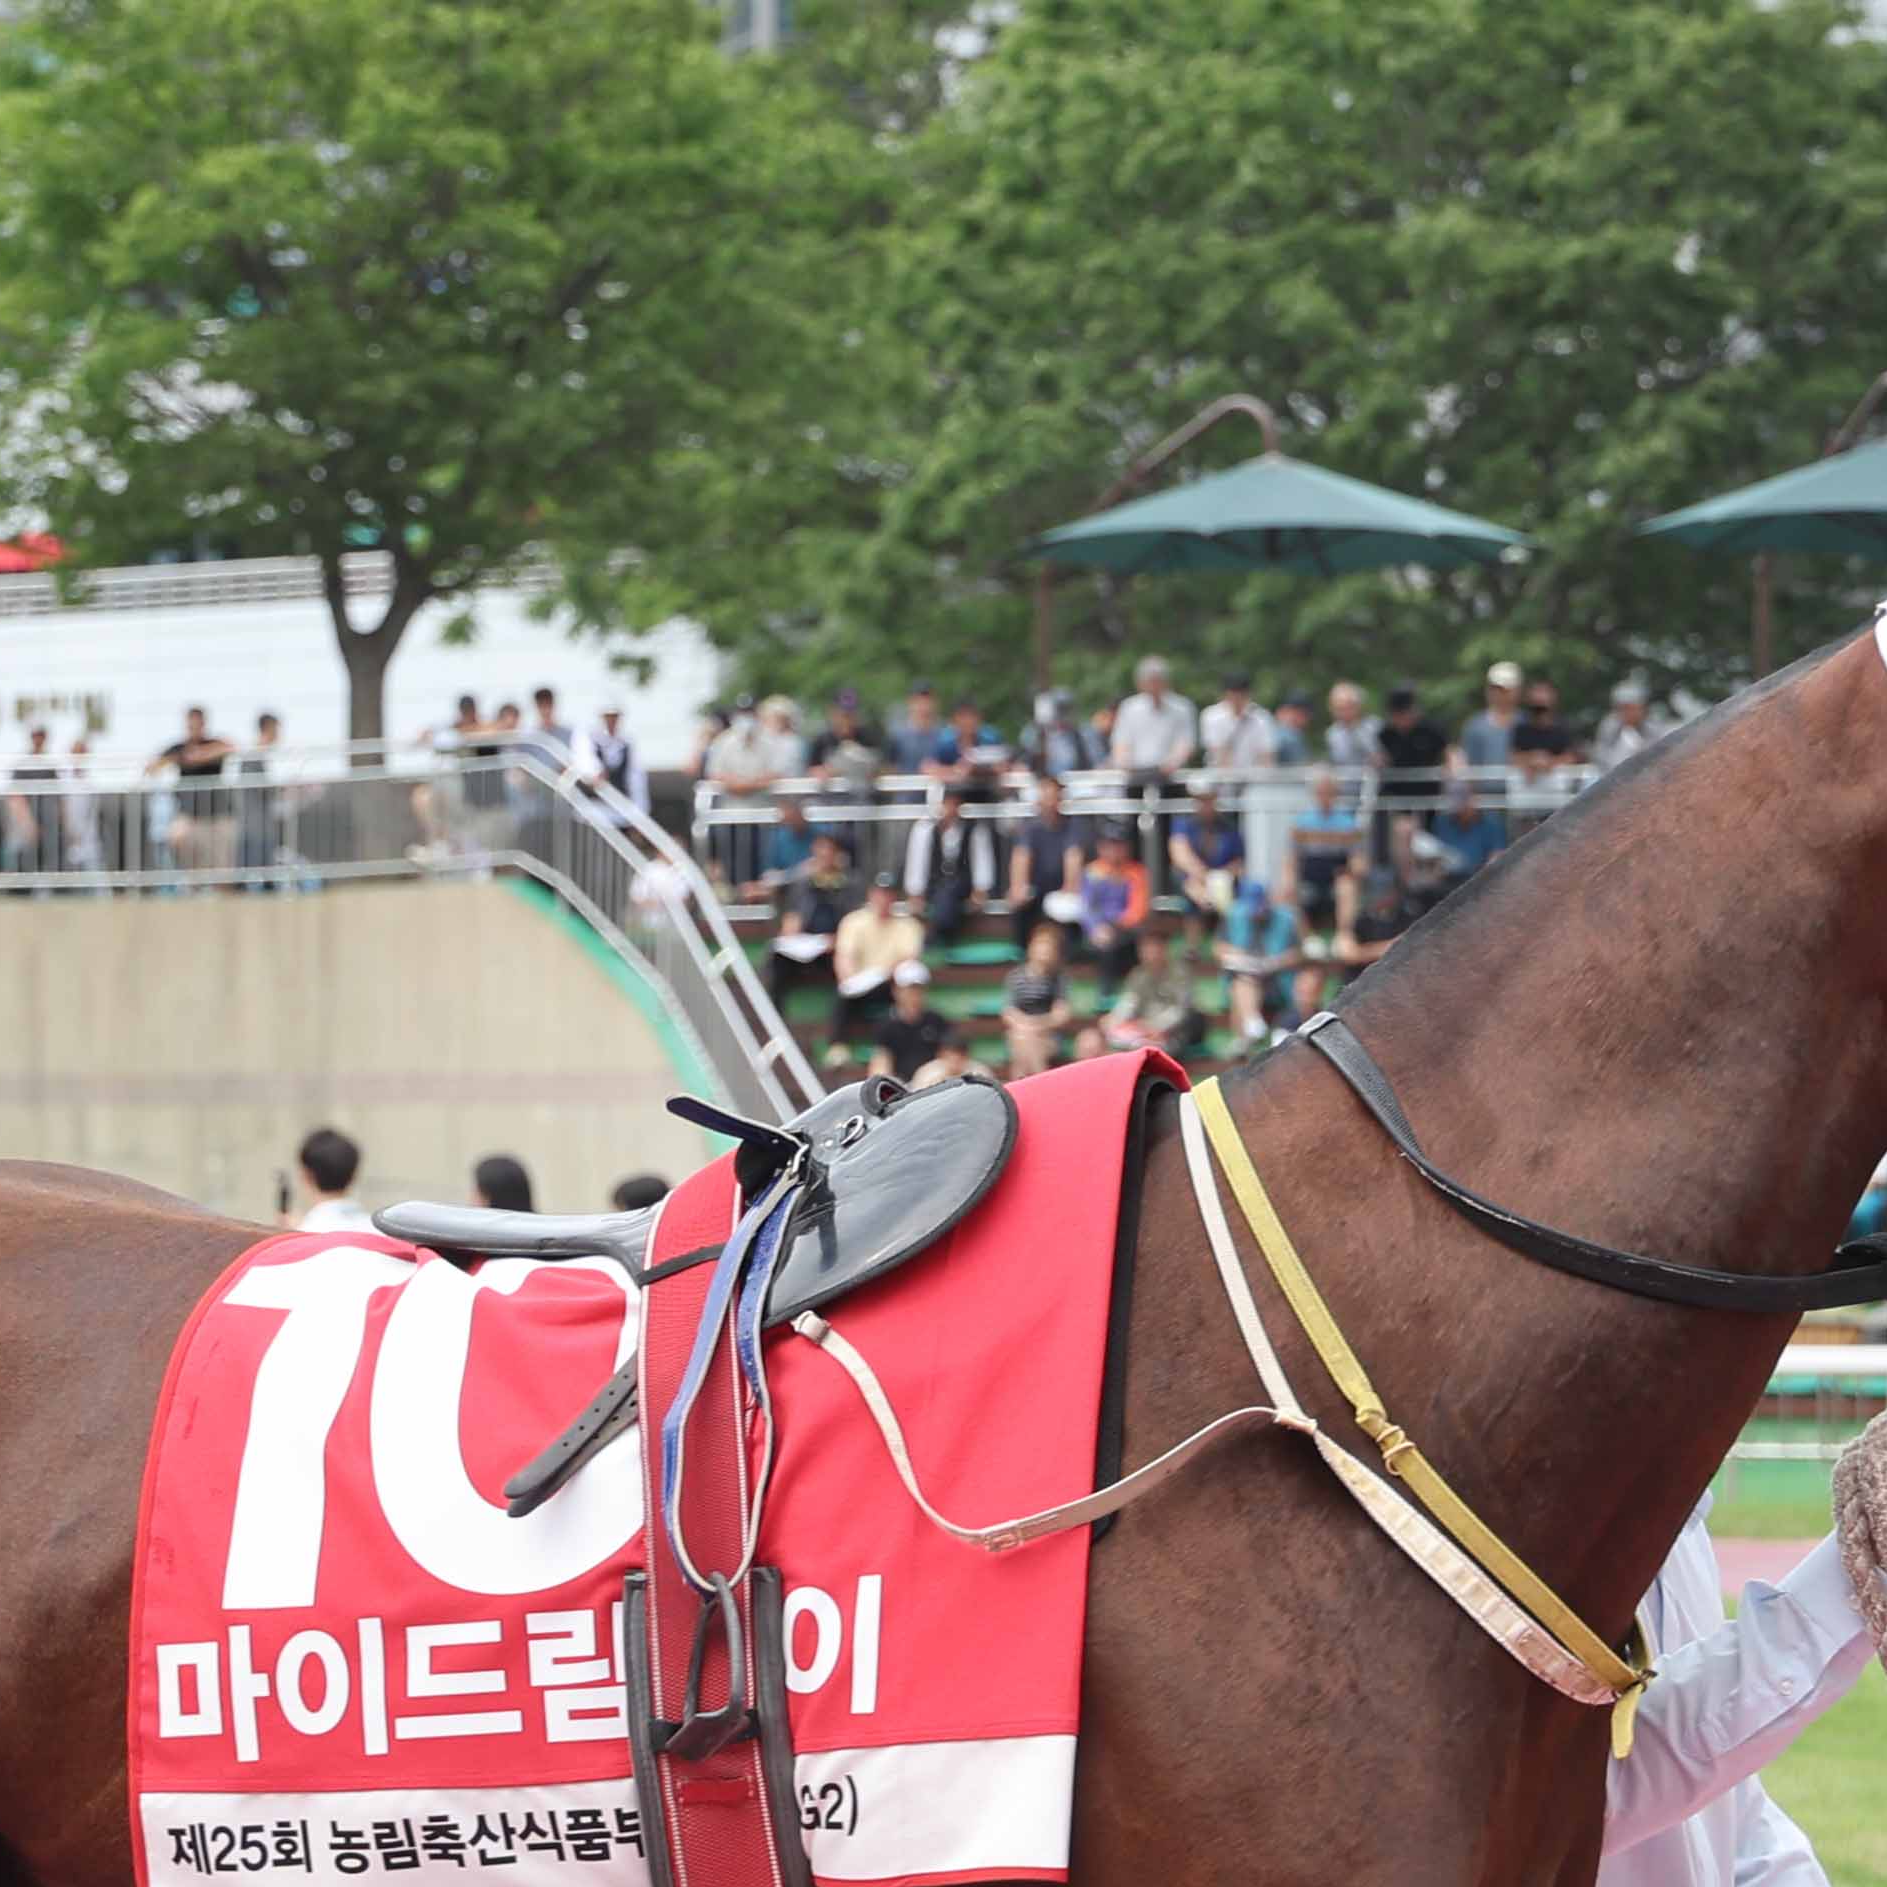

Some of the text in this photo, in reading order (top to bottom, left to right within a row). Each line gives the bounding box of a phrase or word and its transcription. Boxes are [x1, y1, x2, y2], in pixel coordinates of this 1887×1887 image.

[221, 1245, 646, 1611] 10
[156, 1573, 882, 1763] 마이드림이
[167, 1818, 315, 1876] 제25회
